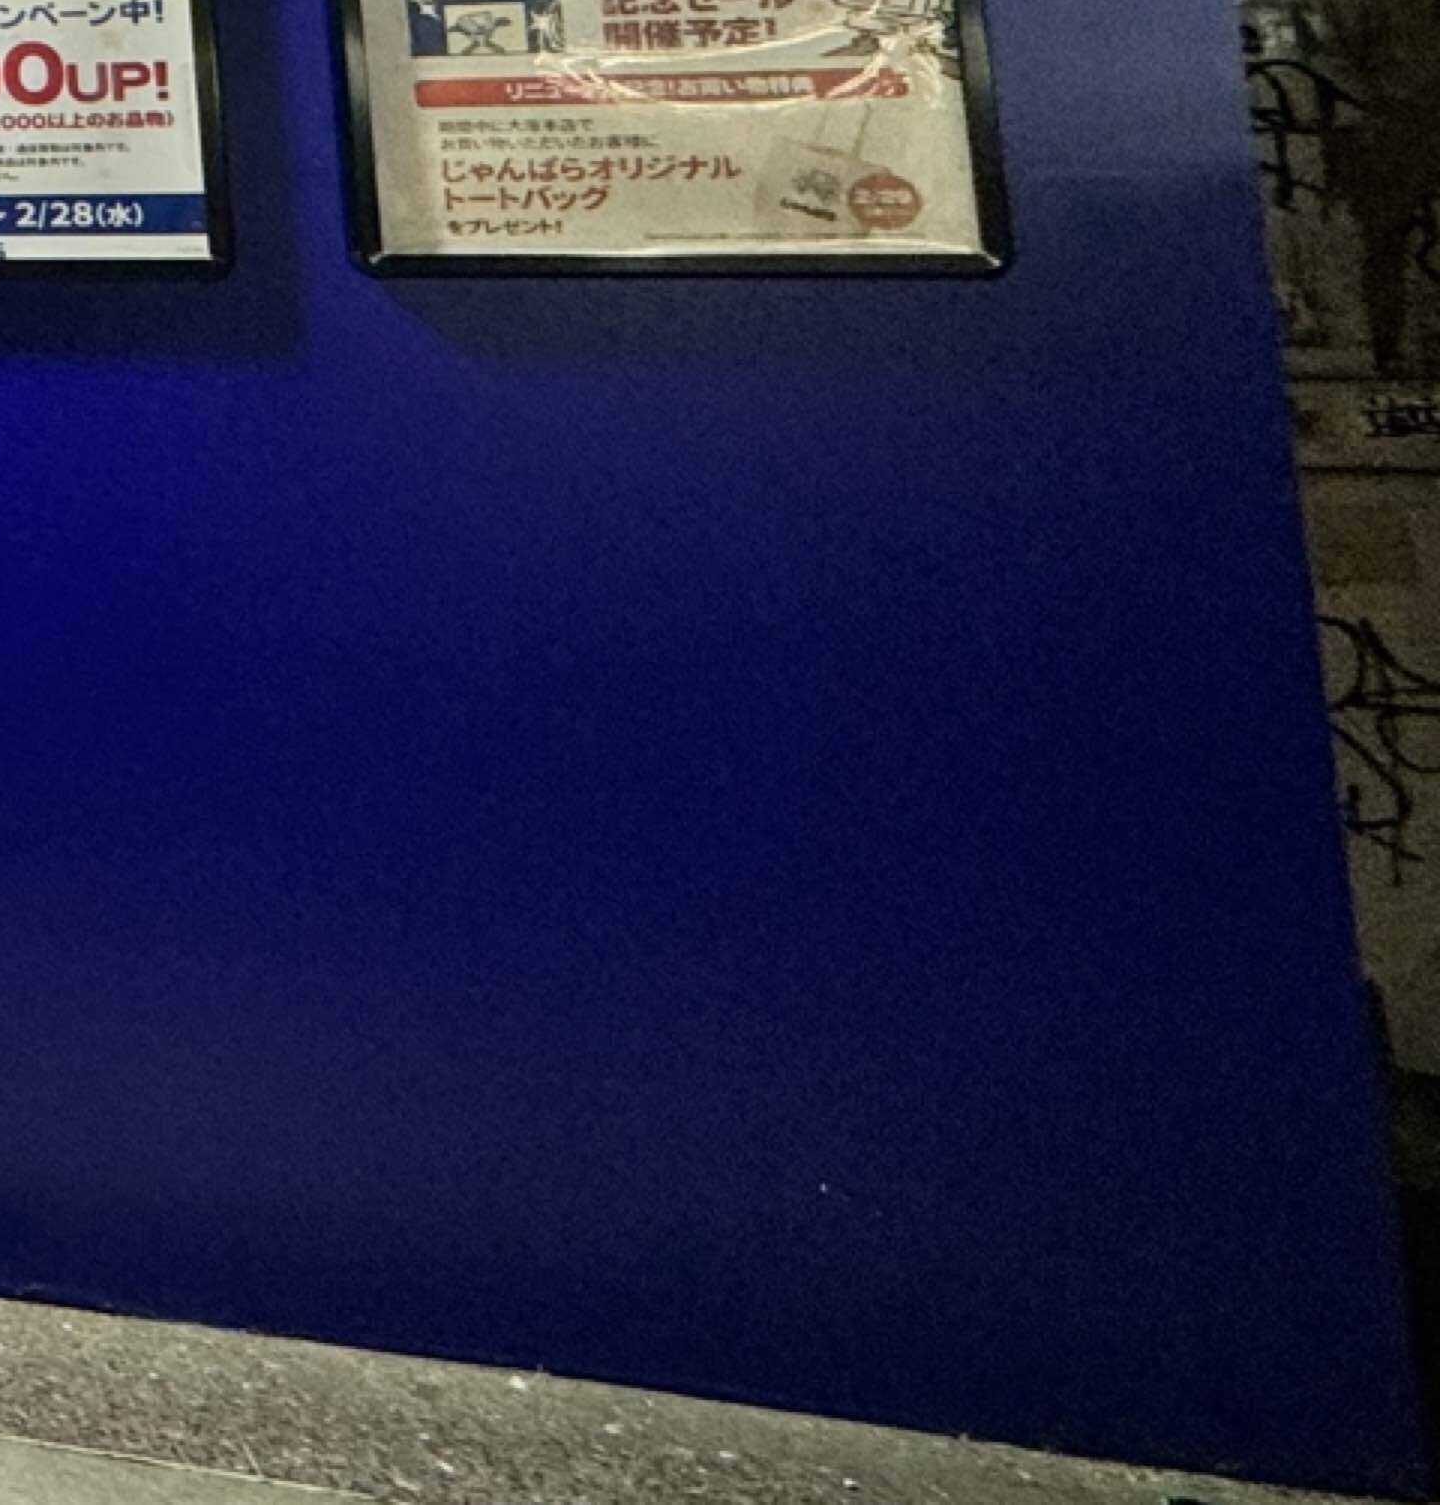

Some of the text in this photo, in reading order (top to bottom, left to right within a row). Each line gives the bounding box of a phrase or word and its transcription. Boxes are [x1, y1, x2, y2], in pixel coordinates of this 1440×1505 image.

[603, 15, 778, 52] 開催予定!
[443, 186, 609, 211] トートバッグ
[15, 200, 145, 228] 2/28(水)
[447, 219, 563, 236] をプレゼント!
